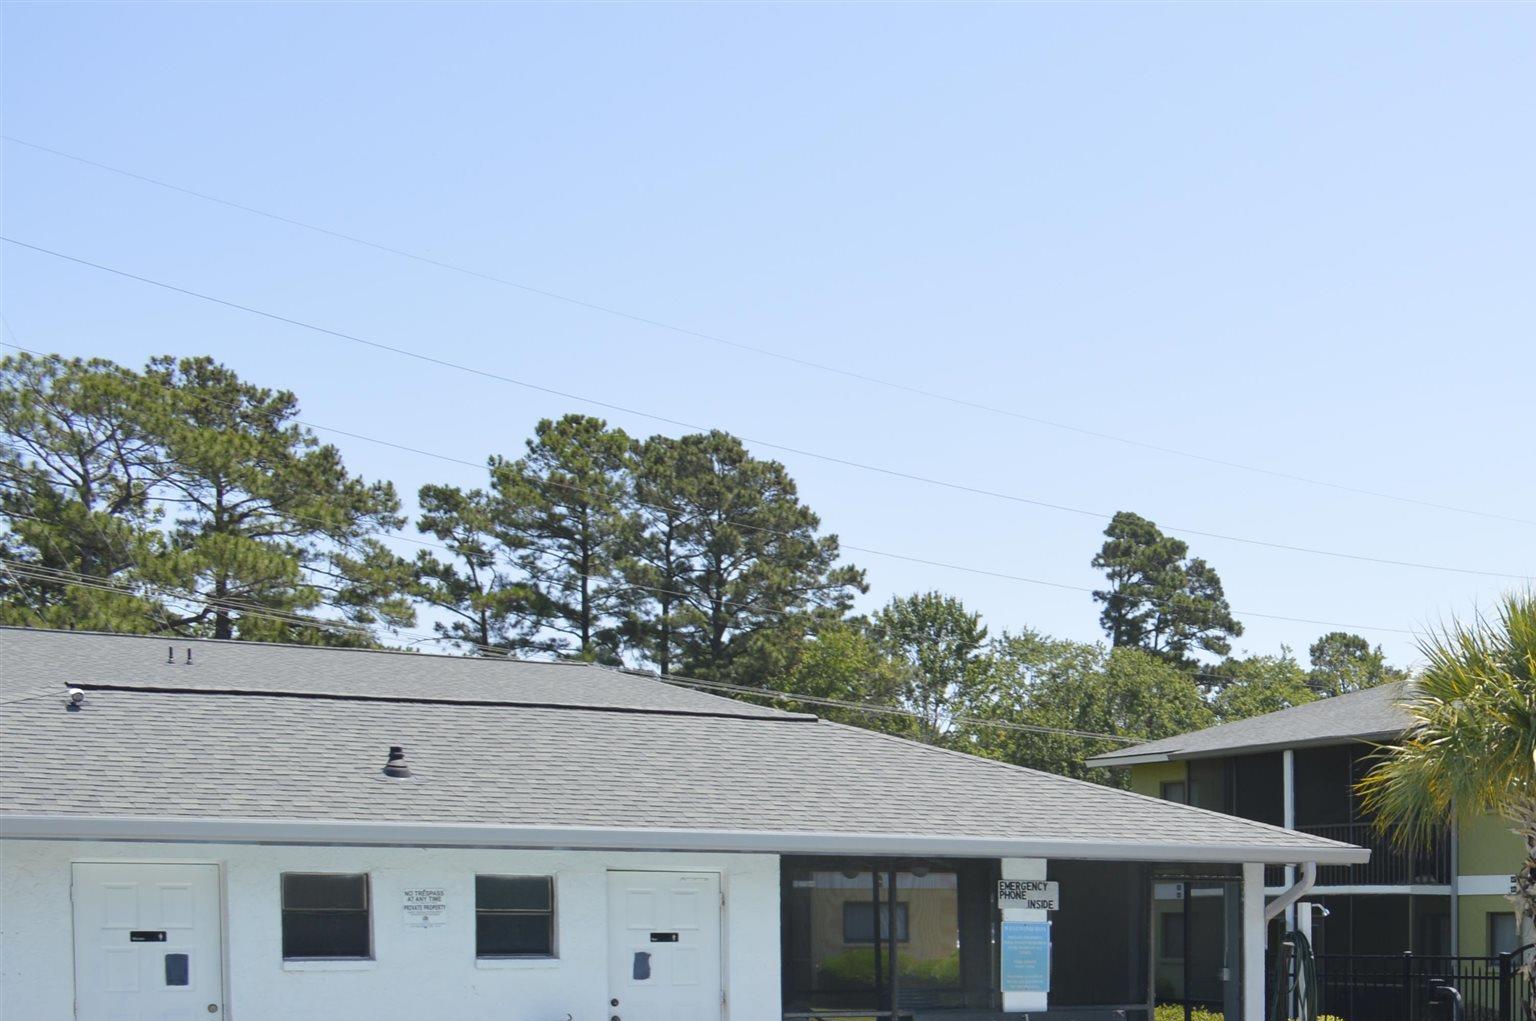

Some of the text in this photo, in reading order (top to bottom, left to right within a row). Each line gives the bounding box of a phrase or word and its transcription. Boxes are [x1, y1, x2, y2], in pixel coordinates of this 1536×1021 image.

[1000, 881, 1048, 891] EMERGENCY
[1000, 890, 1027, 900] PHONE
[1026, 900, 1053, 910] INSIDE
